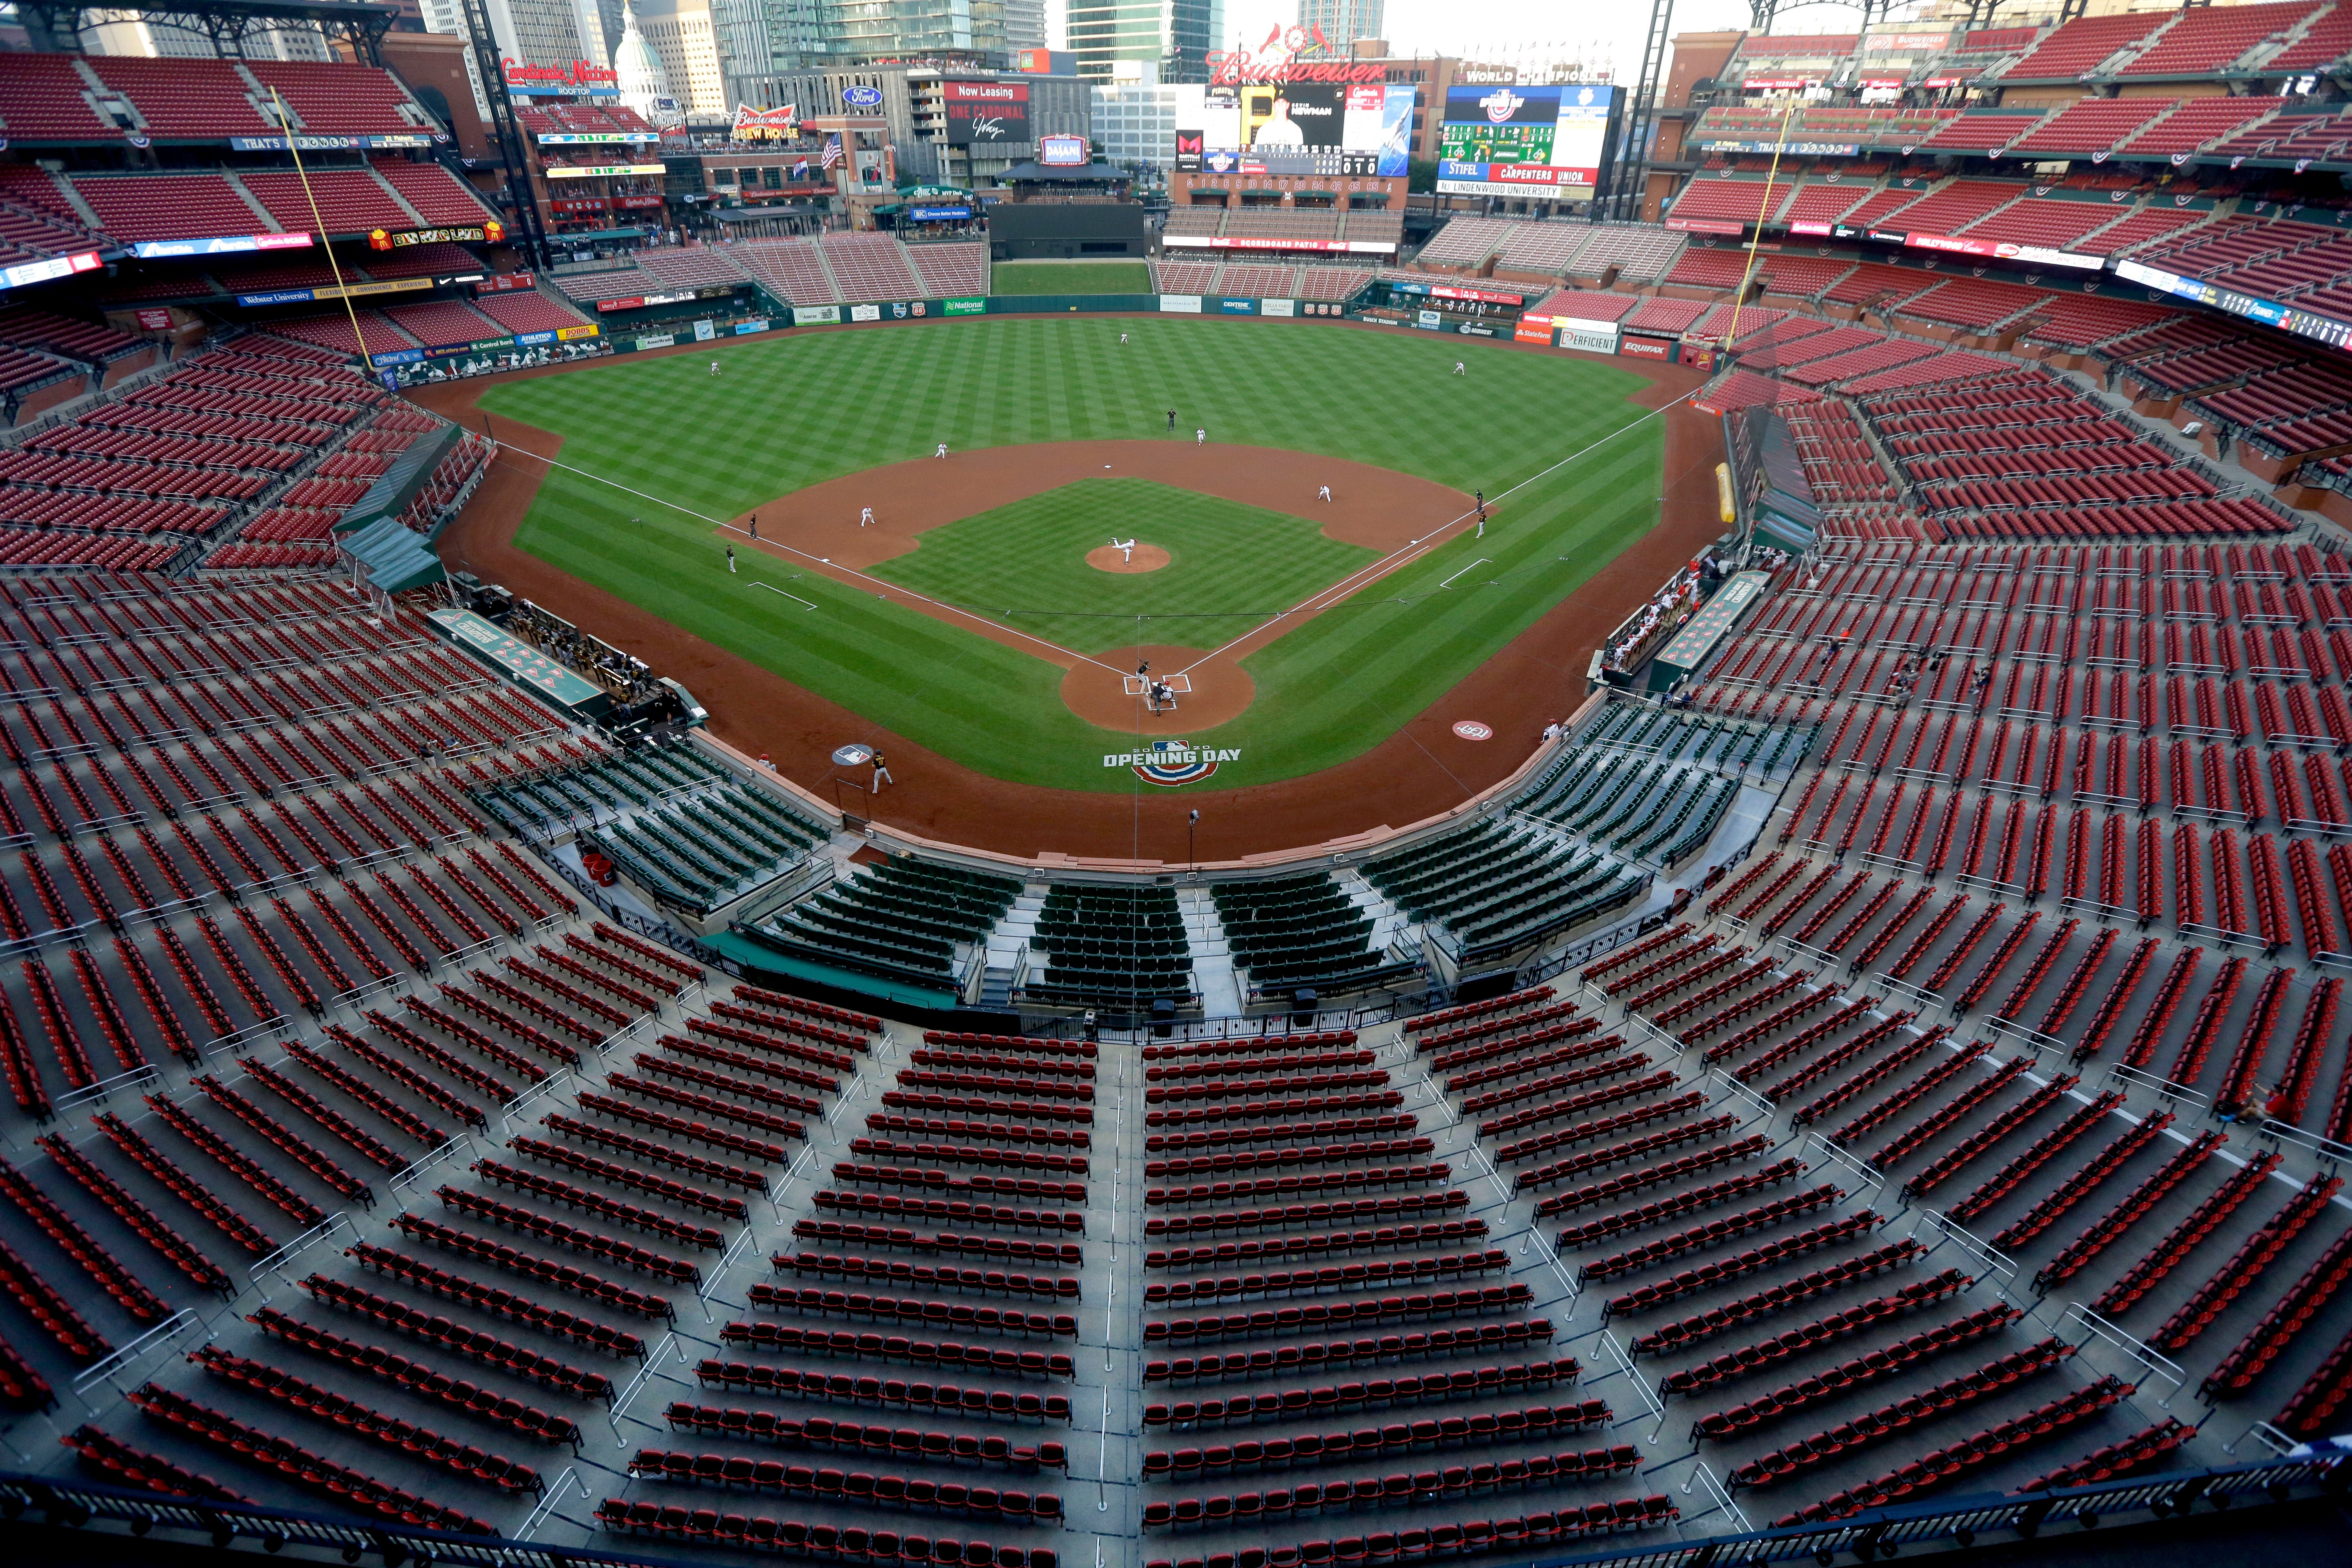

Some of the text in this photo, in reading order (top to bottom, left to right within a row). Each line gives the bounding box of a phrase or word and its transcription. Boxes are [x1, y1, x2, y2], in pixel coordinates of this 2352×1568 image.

[501, 58, 618, 85] Cardinals Nation
[1205, 51, 1388, 84] Budweiser
[1467, 71, 1598, 83] WORLD CHAMPIONS
[852, 89, 875, 103] Ford
[959, 86, 1013, 99] Now Leasing
[1480, 98, 1525, 107] OPENING DAY
[949, 105, 1025, 119] ONE CARDINAL
[1291, 107, 1332, 116] NEWMAN
[653, 115, 686, 125] MIDWEST
[735, 111, 795, 126] Budweiser
[733, 128, 798, 139] BREW HOUSE
[242, 138, 350, 148] THAT'S POWER
[1046, 144, 1080, 158] DASANI
[1343, 162, 1375, 174] 0 1 0
[1449, 163, 1478, 175] STIFEL
[1501, 169, 1584, 182] CARPENTERS UNION
[1202, 178, 1379, 192] 1 2 6 9 10 14 17 20 24 42 45 85
[1454, 183, 1557, 196] LINDENWOOD UNIVERSITY
[392, 229, 484, 246] BIG MAC LAND
[1915, 237, 1963, 250] HOLLYWOOD
[1963, 240, 1985, 253] Casino
[320, 287, 351, 296] FLEXIBILTY
[397, 281, 428, 289] EXPERIENCE
[245, 292, 309, 304] Webster University
[955, 301, 983, 309] National
[521, 332, 551, 341] ATHLETICO
[566, 327, 590, 335] DOBBS
[1471, 327, 1493, 336] MIDWEST
[1561, 331, 1614, 349] PERFICIENT
[1624, 343, 1664, 354] EQUIFAX
[456, 622, 493, 644] CHAMPIONS
[1103, 748, 1242, 767] OPENING DAY
